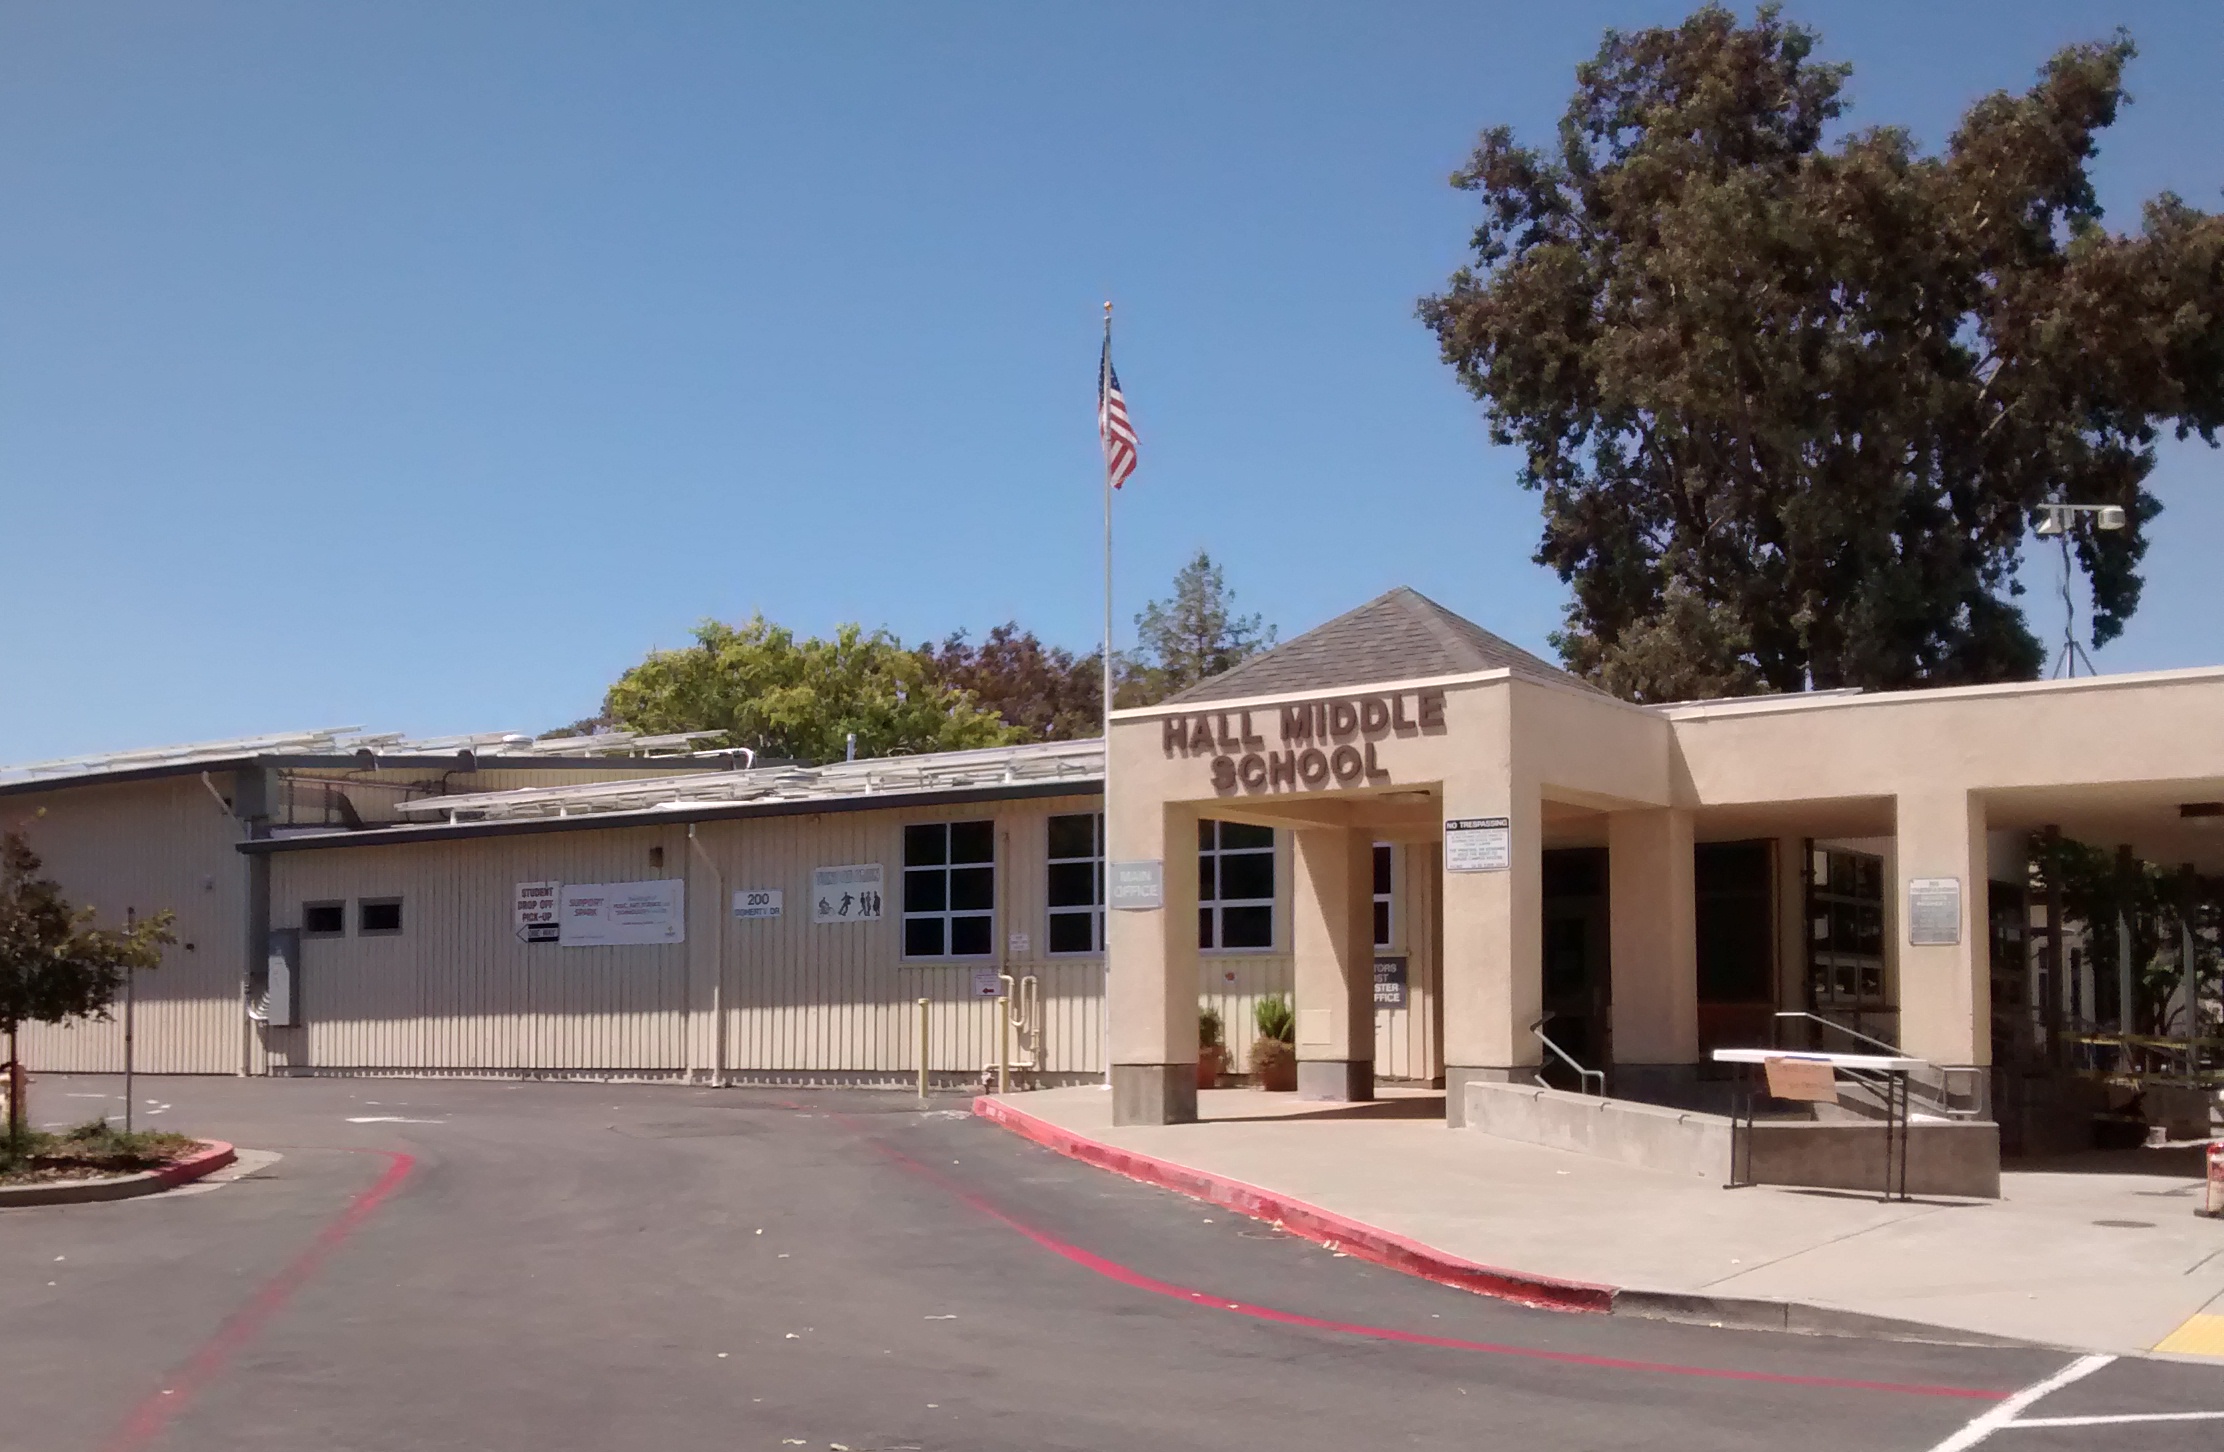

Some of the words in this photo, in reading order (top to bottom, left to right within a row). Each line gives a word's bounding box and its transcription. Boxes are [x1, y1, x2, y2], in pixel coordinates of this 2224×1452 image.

[1162, 710, 1264, 754] HALL
[1280, 689, 1446, 741] MIDDLE
[1210, 743, 1390, 791] SCHOOL
[1460, 819, 1507, 828] TRESPASSING
[1120, 871, 1152, 882] MAIN
[521, 887, 553, 898] STUDENT
[1114, 884, 1158, 897] OFFICE
[517, 900, 537, 910] DROP
[540, 899, 553, 909] OFF
[569, 898, 604, 907] SUPPORT
[747, 893, 770, 905] 200
[769, 907, 780, 915] DR
[522, 912, 552, 922] PICK-UP
[1374, 983, 1399, 992] STER
